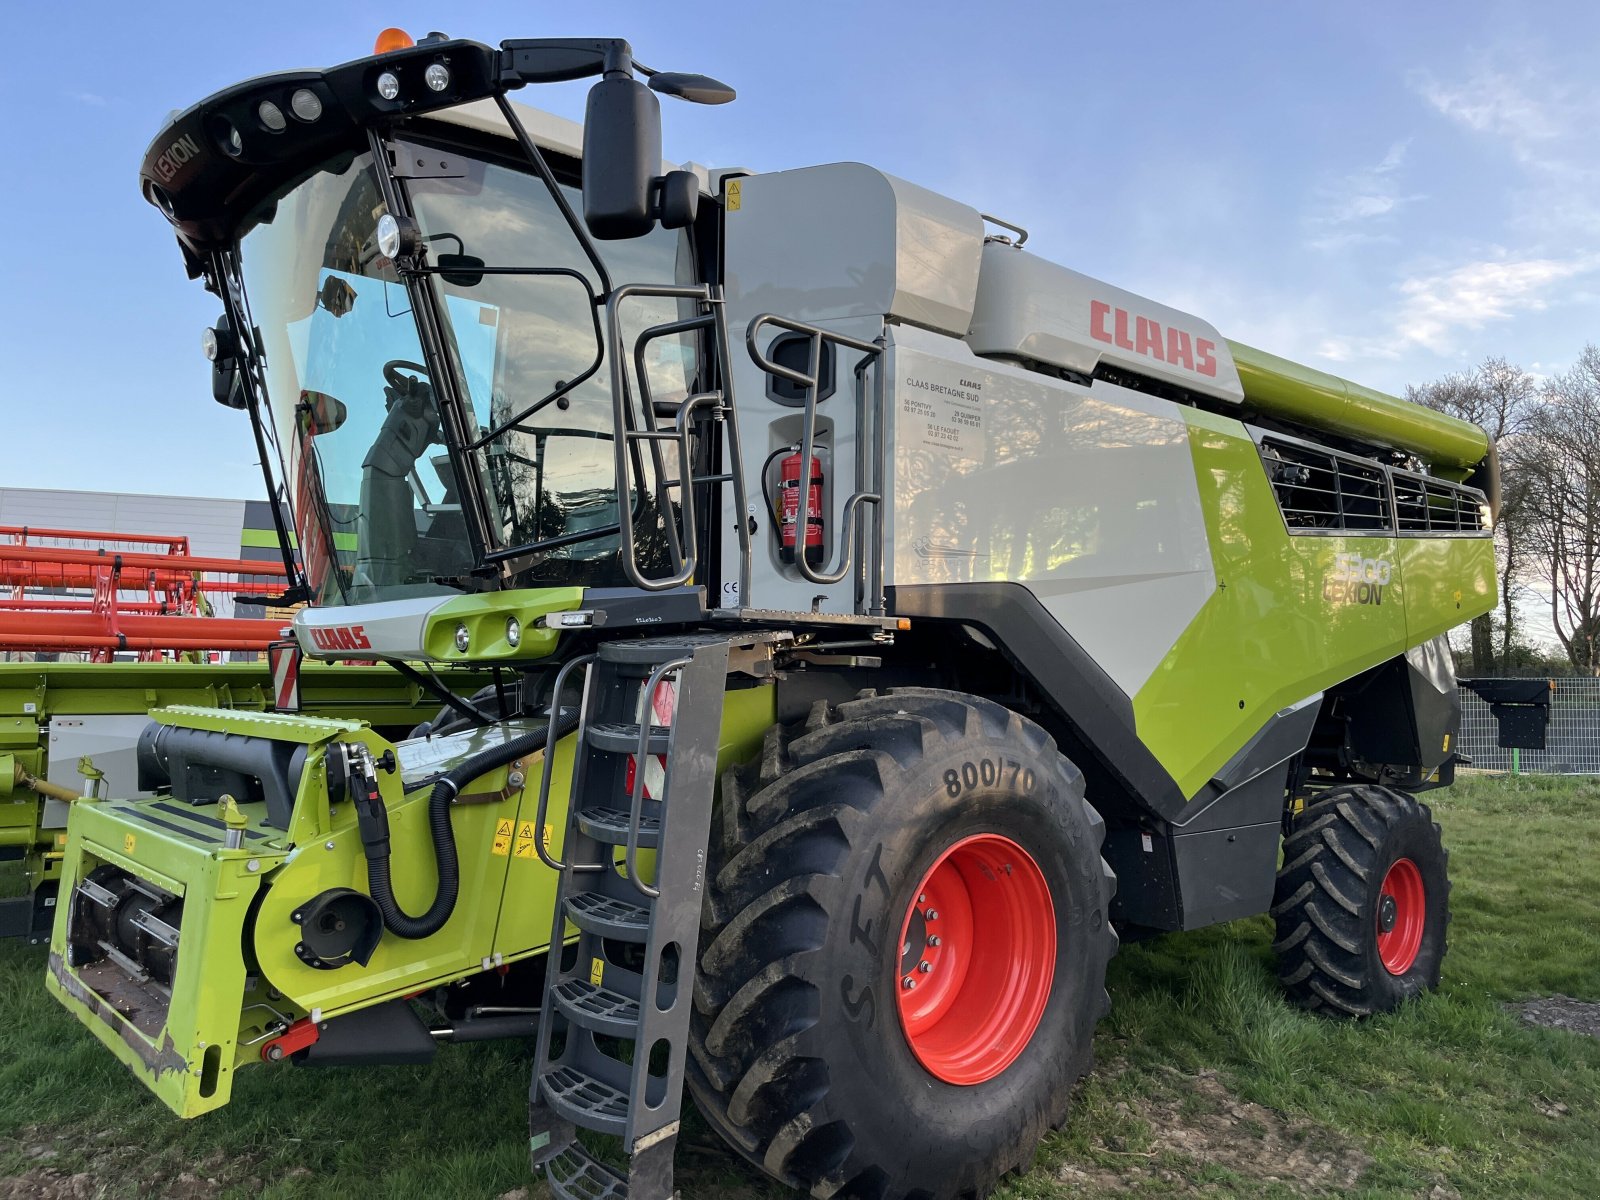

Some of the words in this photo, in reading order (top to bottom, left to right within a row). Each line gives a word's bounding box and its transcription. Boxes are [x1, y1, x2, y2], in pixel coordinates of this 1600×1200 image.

[154, 133, 200, 182] LEXION
[1090, 299, 1217, 378] CLAAS
[906, 377, 929, 390] CLAAS
[930, 383, 965, 399] BRETAGNE
[966, 392, 979, 403] SUD
[960, 379, 982, 390] CLAAS
[910, 400, 932, 410] PONTIVY
[1323, 576, 1382, 605] LEXION
[309, 626, 371, 650] CLAAS
[944, 757, 1036, 798] 800/70
